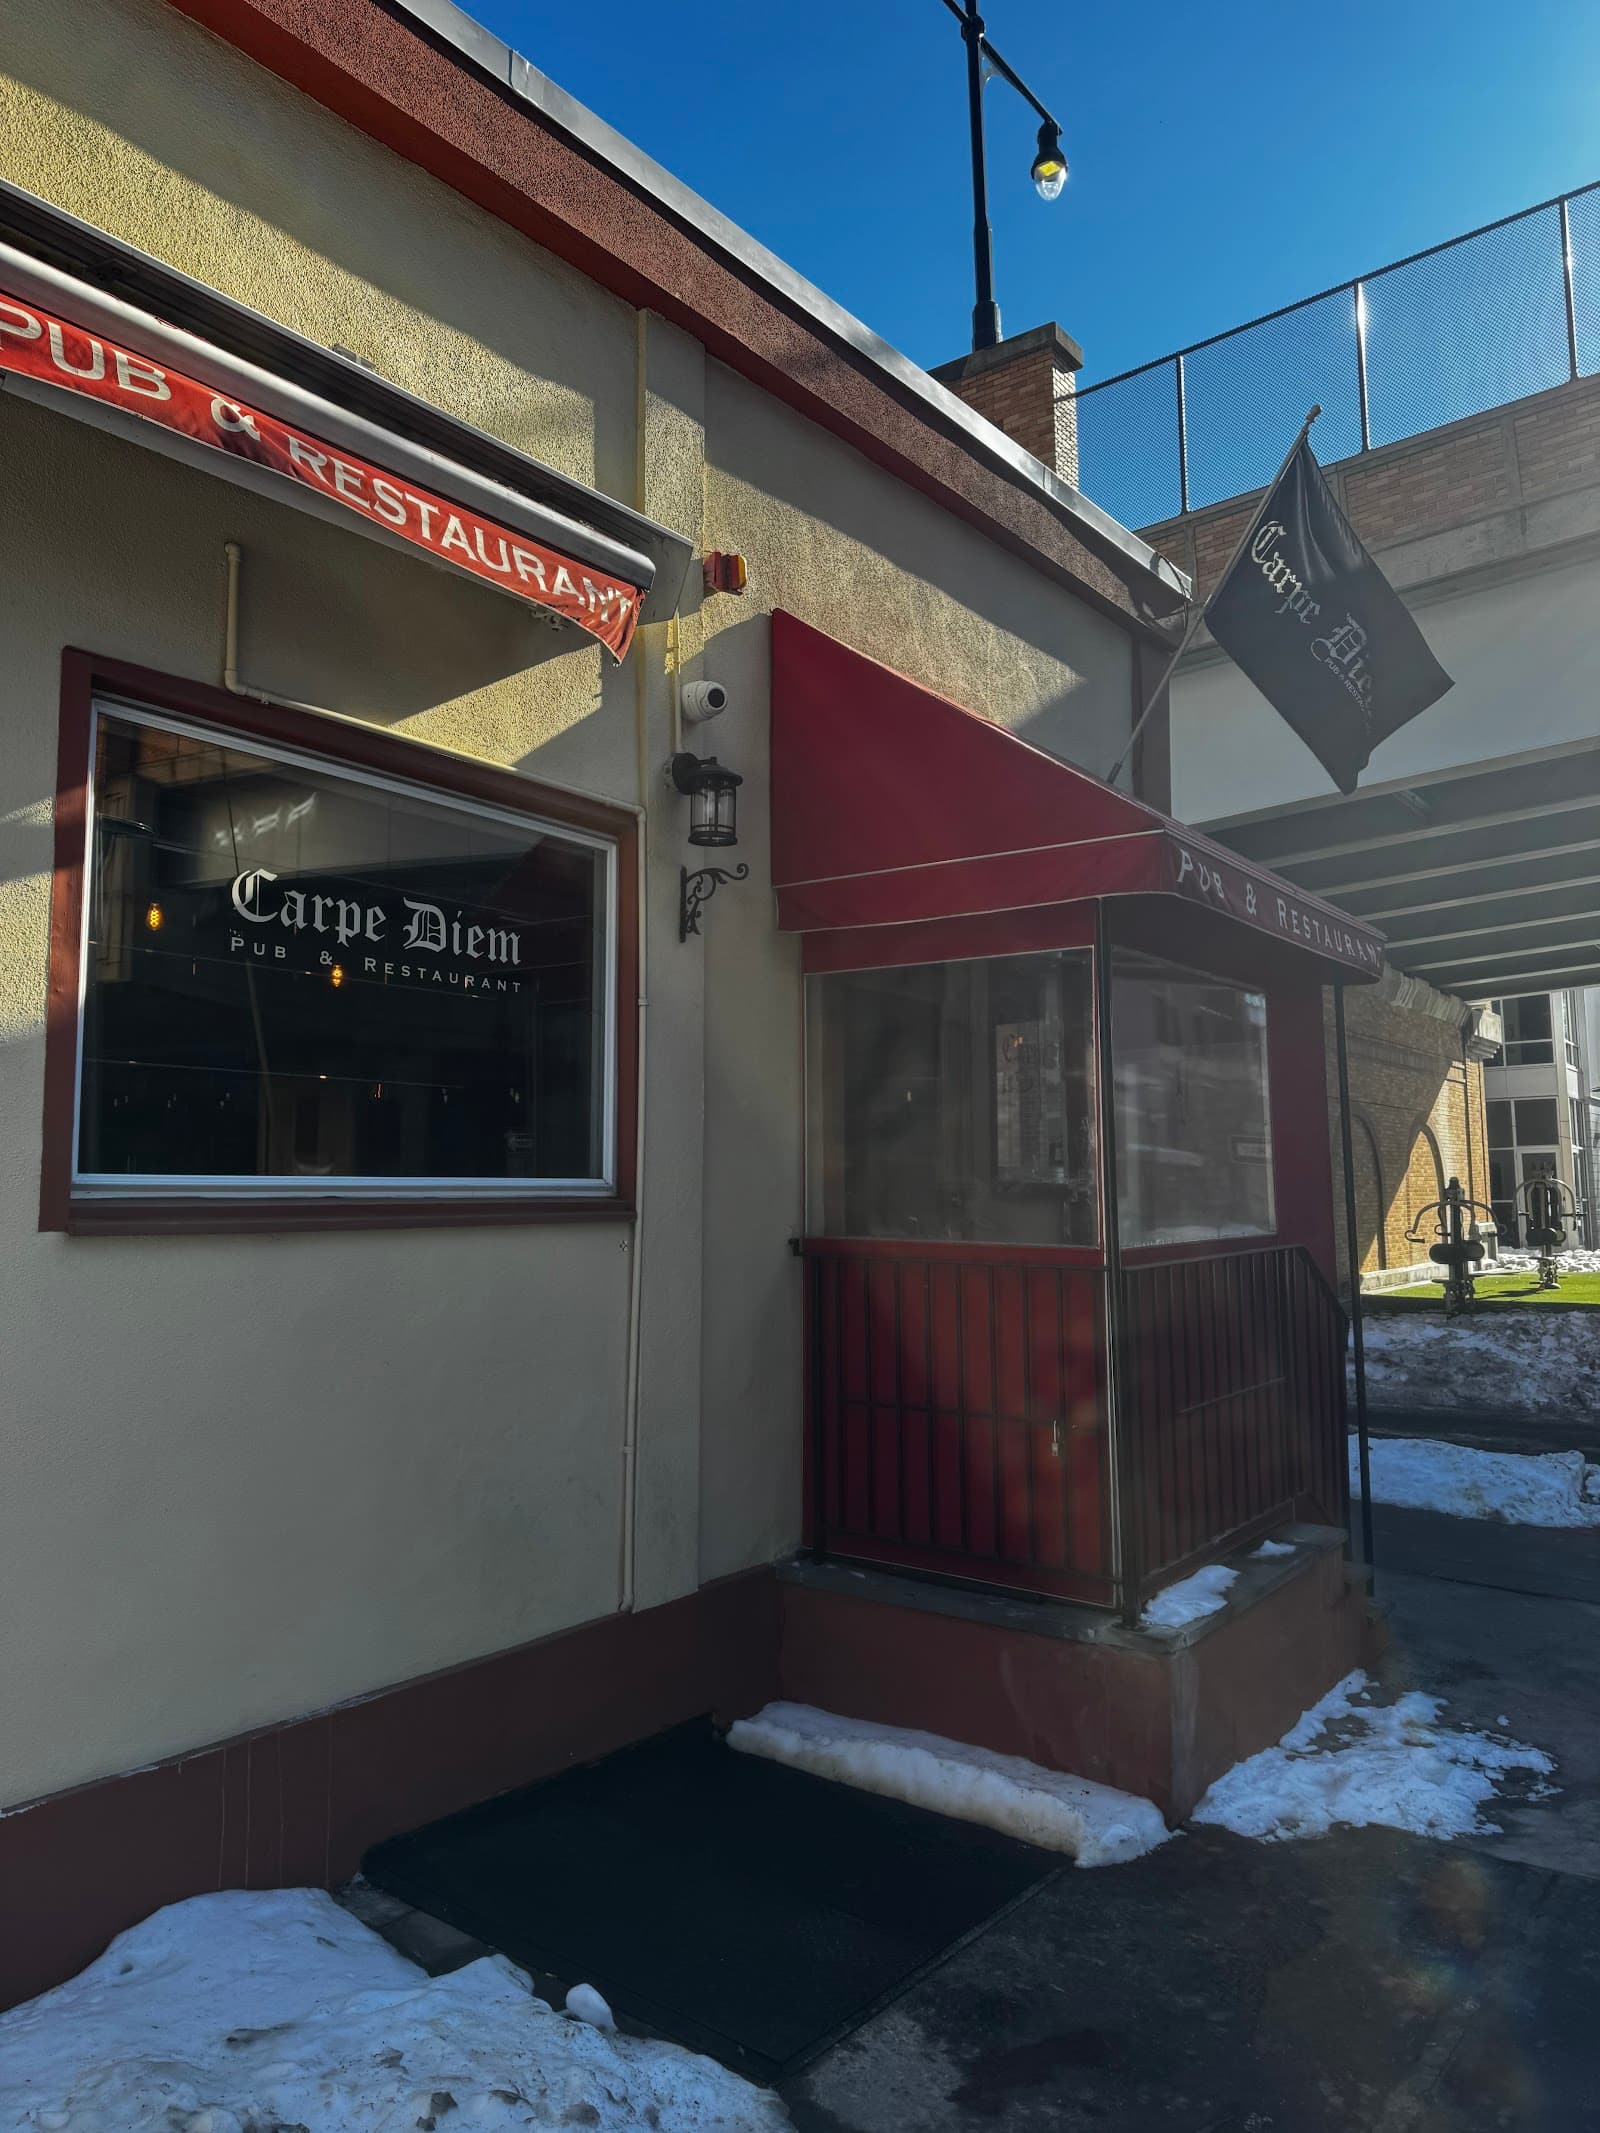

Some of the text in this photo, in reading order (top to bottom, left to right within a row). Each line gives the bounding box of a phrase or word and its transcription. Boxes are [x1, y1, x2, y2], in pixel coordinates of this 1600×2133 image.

[0, 305, 634, 624] PUB & RESTAURANT
[1251, 520, 1321, 625] Carpe
[231, 868, 521, 965] Carpe Diem
[1177, 849, 1383, 967] PUB & RESTAURANT
[230, 936, 521, 993] PUB & RESTAURANT
